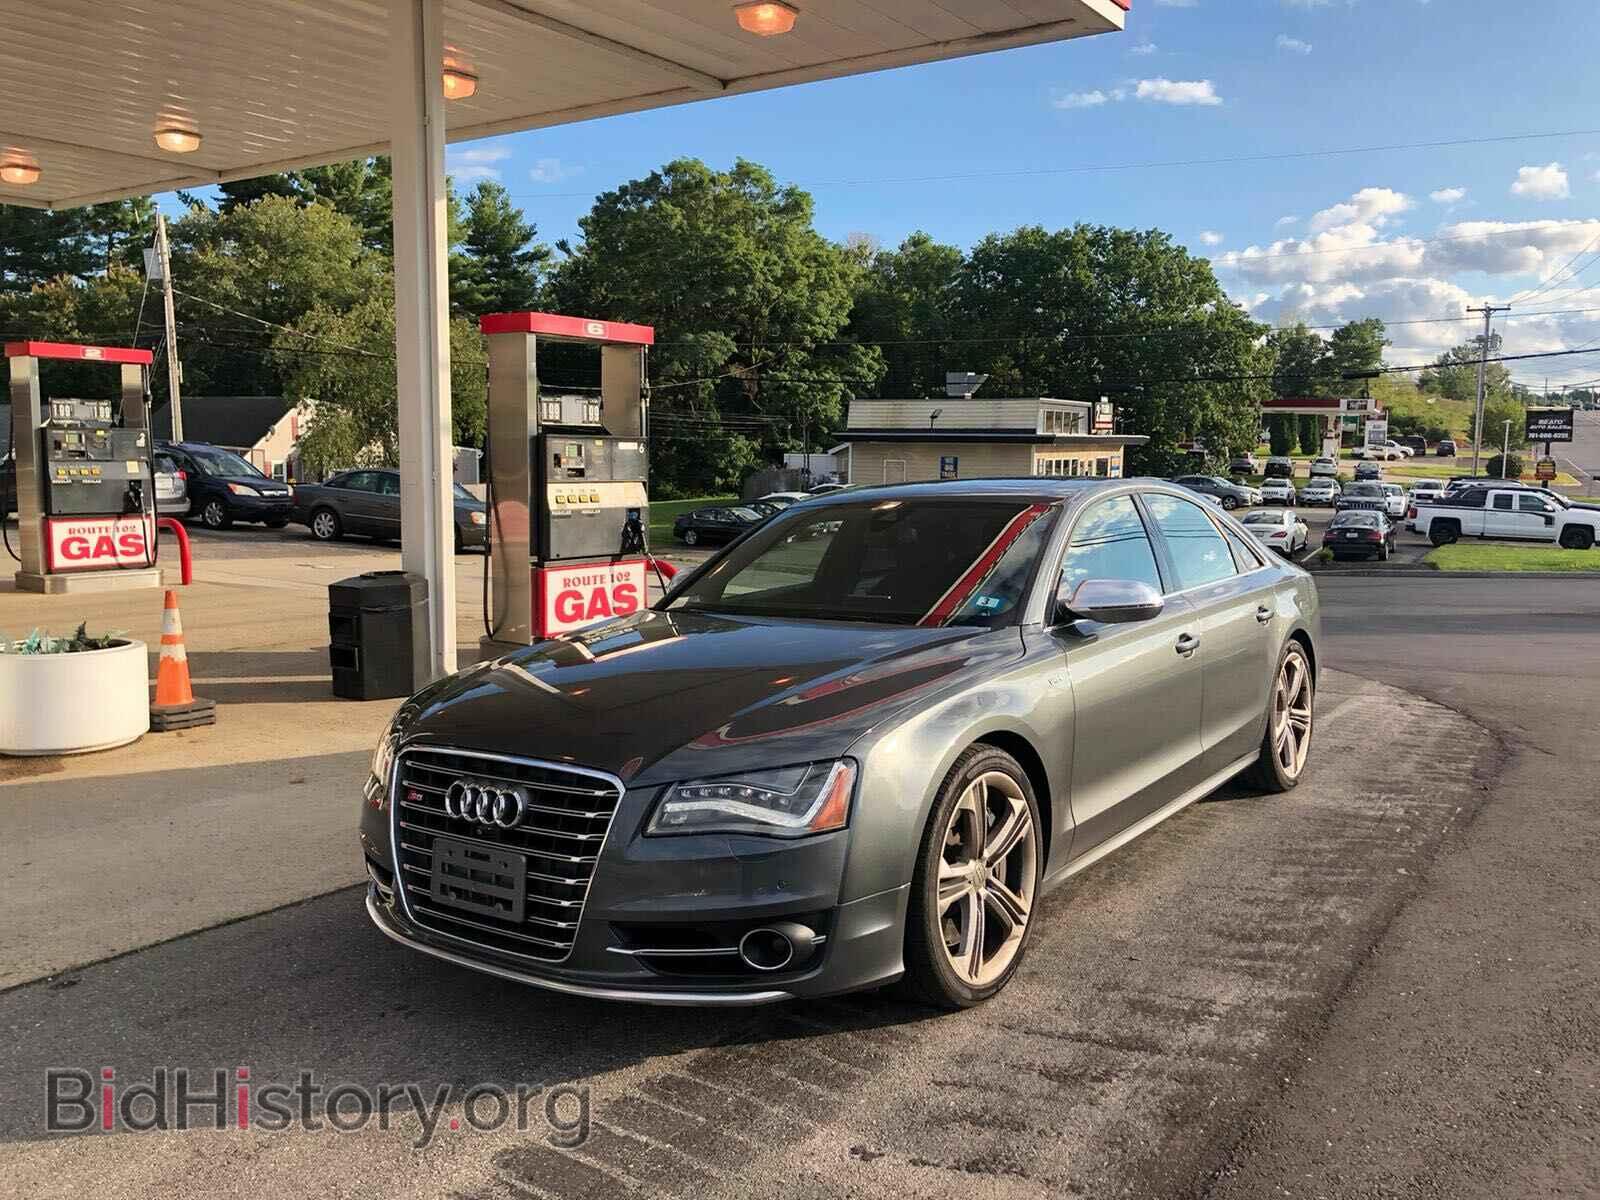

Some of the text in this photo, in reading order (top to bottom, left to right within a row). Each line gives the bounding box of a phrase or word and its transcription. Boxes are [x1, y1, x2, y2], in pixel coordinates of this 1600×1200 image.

[587, 322, 604, 335] 6
[638, 444, 645, 454] 6
[68, 524, 136, 536] ROUTE 102
[61, 535, 145, 560] GAS
[563, 571, 631, 588] ROUTE 102
[555, 584, 638, 624] GAS
